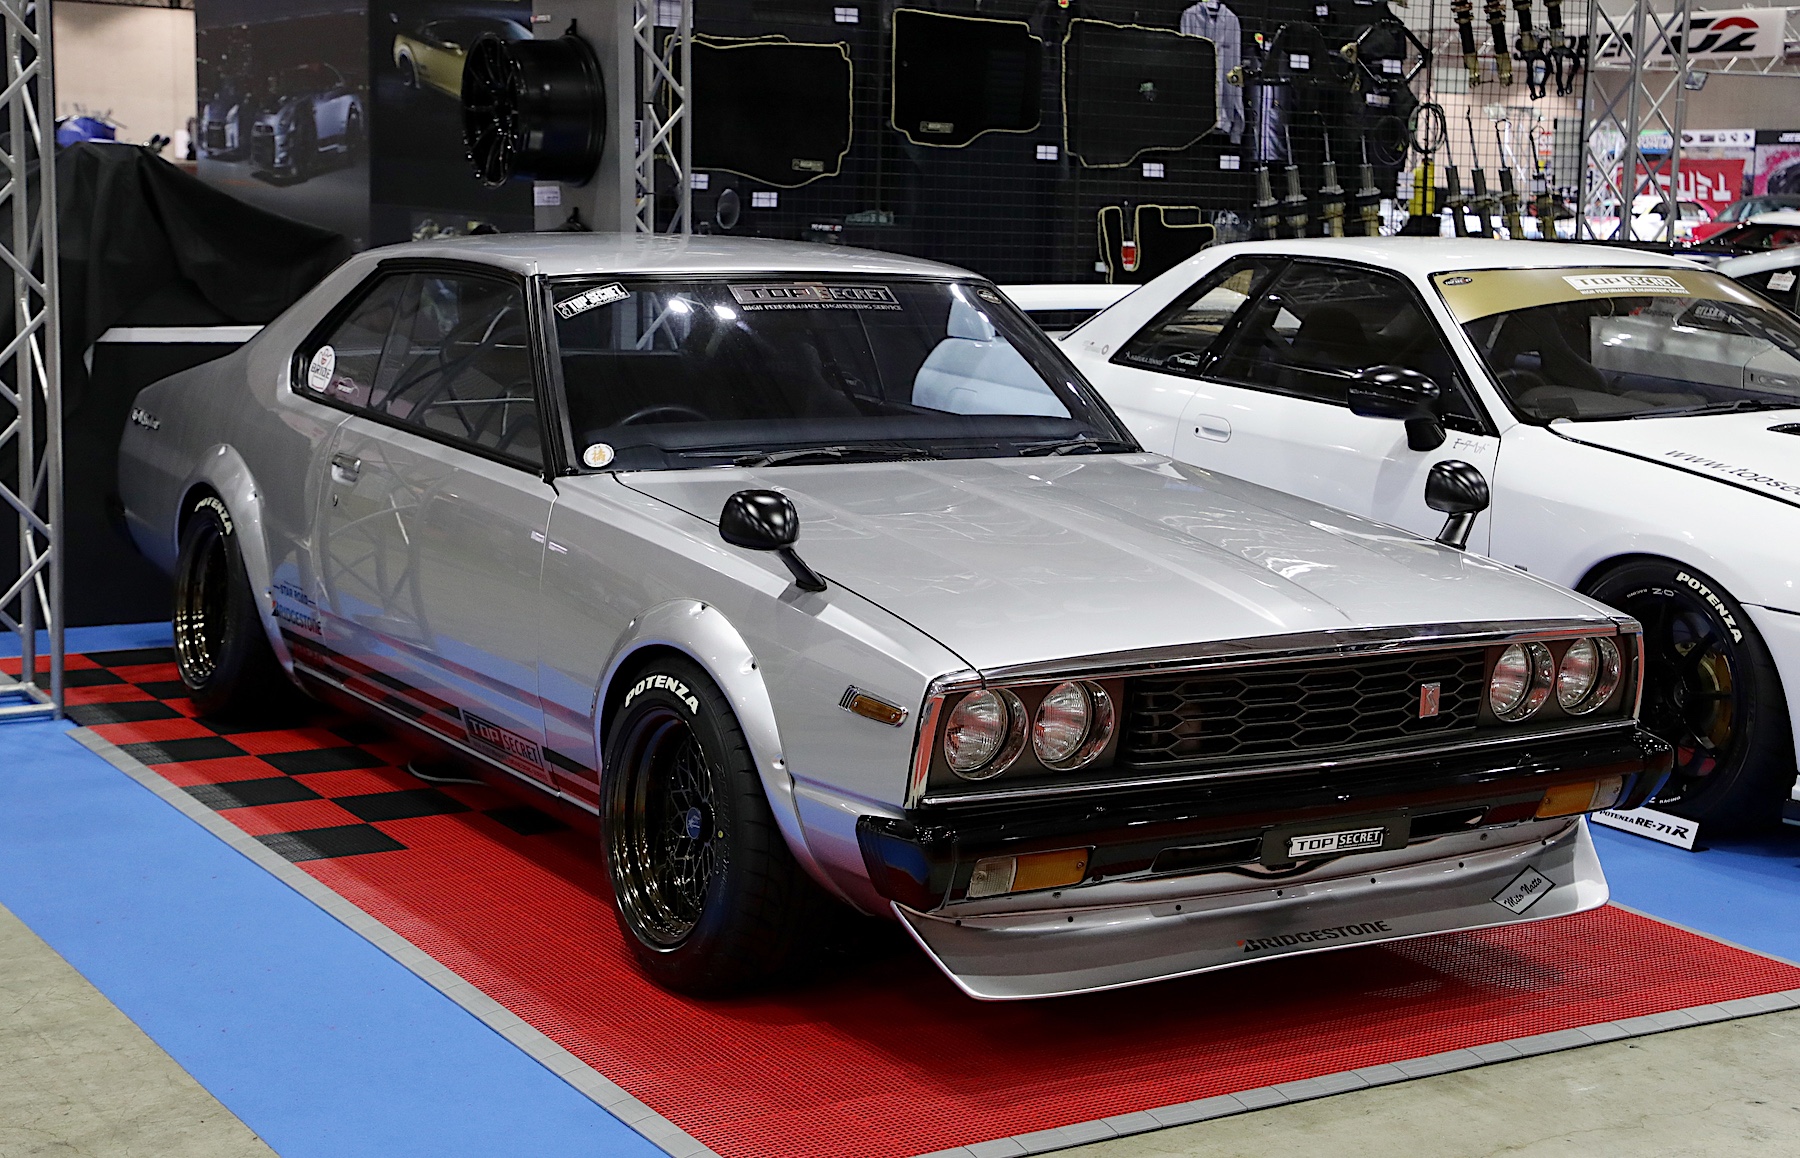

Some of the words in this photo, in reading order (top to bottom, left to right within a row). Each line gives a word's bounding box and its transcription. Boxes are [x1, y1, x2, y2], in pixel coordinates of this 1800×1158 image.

[744, 288, 812, 299] TOP
[816, 286, 890, 301] SECRET
[1578, 277, 1621, 286] TOP
[1623, 276, 1681, 288] SECRET
[310, 362, 332, 380] BRIDE
[194, 497, 234, 535] POTENZA
[272, 601, 322, 635] BRIDGESTONE
[1676, 571, 1743, 643] POTENZA
[624, 674, 700, 715] POTENZA
[468, 718, 500, 743] TOP
[502, 734, 539, 764] SECRET
[1297, 838, 1334, 851] TOP
[1338, 831, 1380, 845] SECRET
[1600, 810, 1634, 824] POTENZA
[1635, 817, 1690, 840] RE-71R
[1238, 921, 1392, 953] BRIDGESTONE
